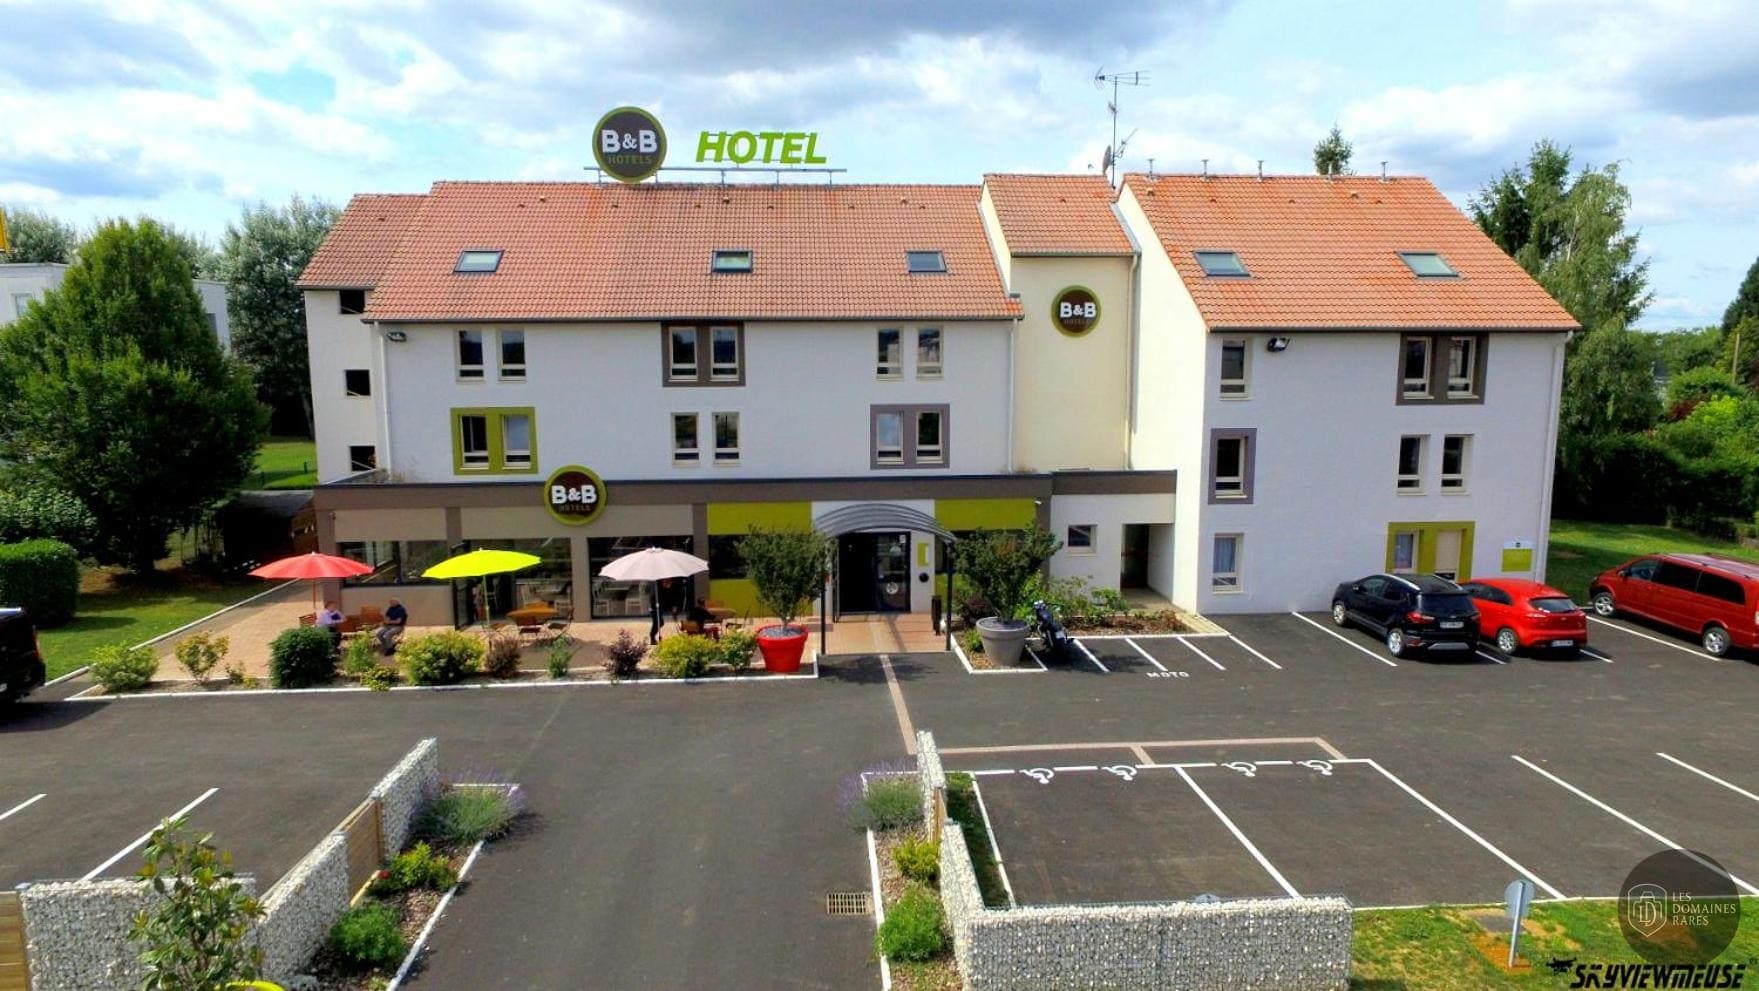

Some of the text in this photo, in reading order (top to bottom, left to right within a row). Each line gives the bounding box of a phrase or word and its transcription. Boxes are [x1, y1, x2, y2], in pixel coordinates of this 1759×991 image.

[601, 129, 658, 153] B&B
[695, 130, 827, 164] HOTEL
[608, 154, 652, 165] HOTELS
[1060, 301, 1097, 318] B&B
[551, 484, 597, 504] B&B
